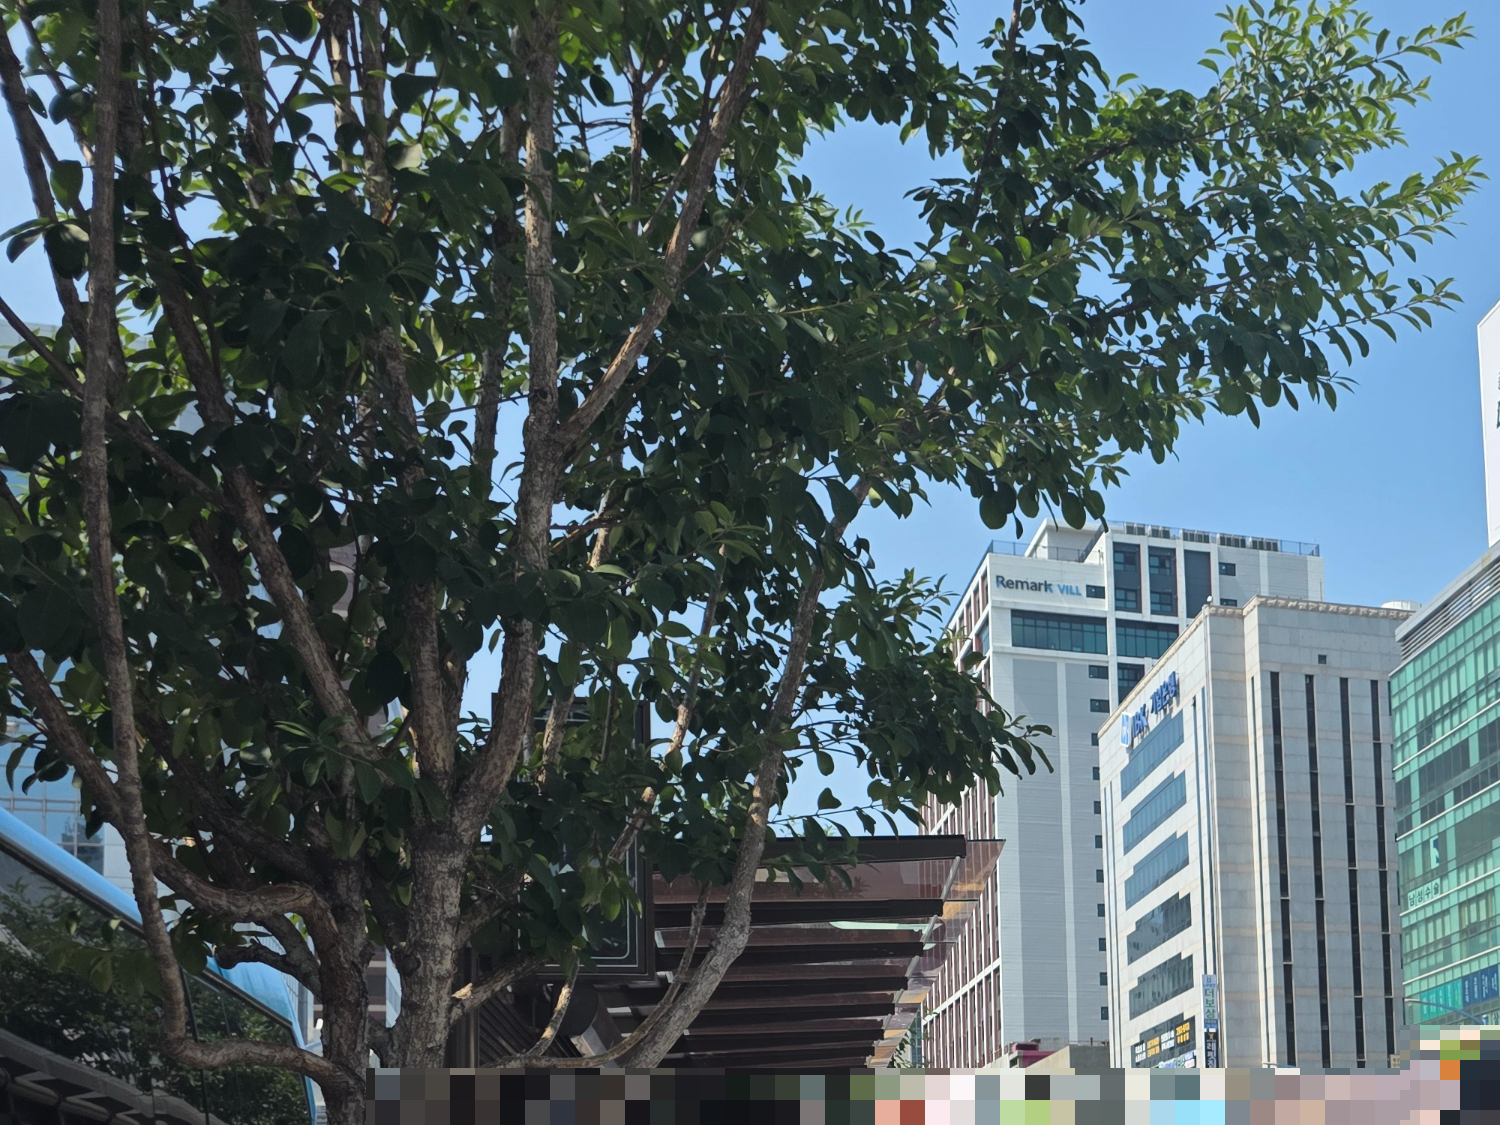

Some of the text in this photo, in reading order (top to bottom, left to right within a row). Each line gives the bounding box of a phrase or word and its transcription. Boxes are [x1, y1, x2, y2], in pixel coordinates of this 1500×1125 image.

[995, 574, 1082, 597] Remark VILL
[1131, 703, 1149, 739] IBK
[1408, 880, 1441, 908] 남성수술
